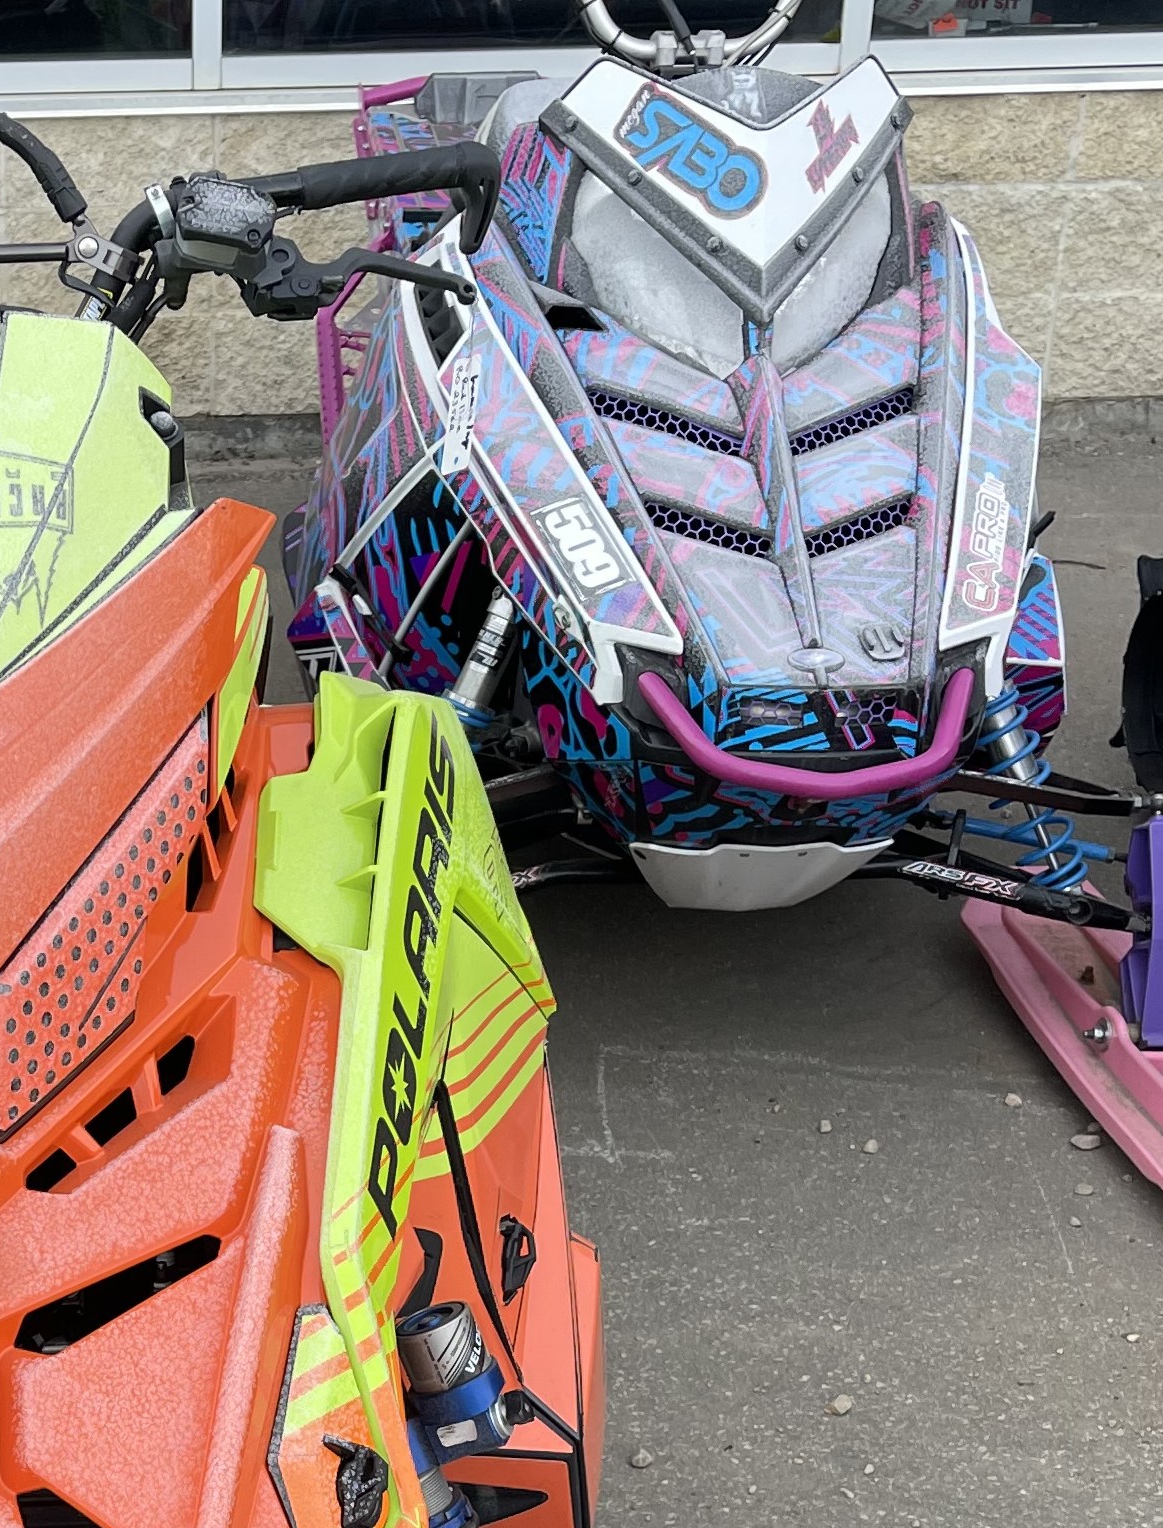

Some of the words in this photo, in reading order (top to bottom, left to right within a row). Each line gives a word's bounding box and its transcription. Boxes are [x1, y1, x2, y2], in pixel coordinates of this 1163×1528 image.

[625, 98, 761, 212] SABO
[544, 503, 620, 588] 509
[972, 492, 1000, 559] PRO
[368, 709, 456, 1243] POLARIS
